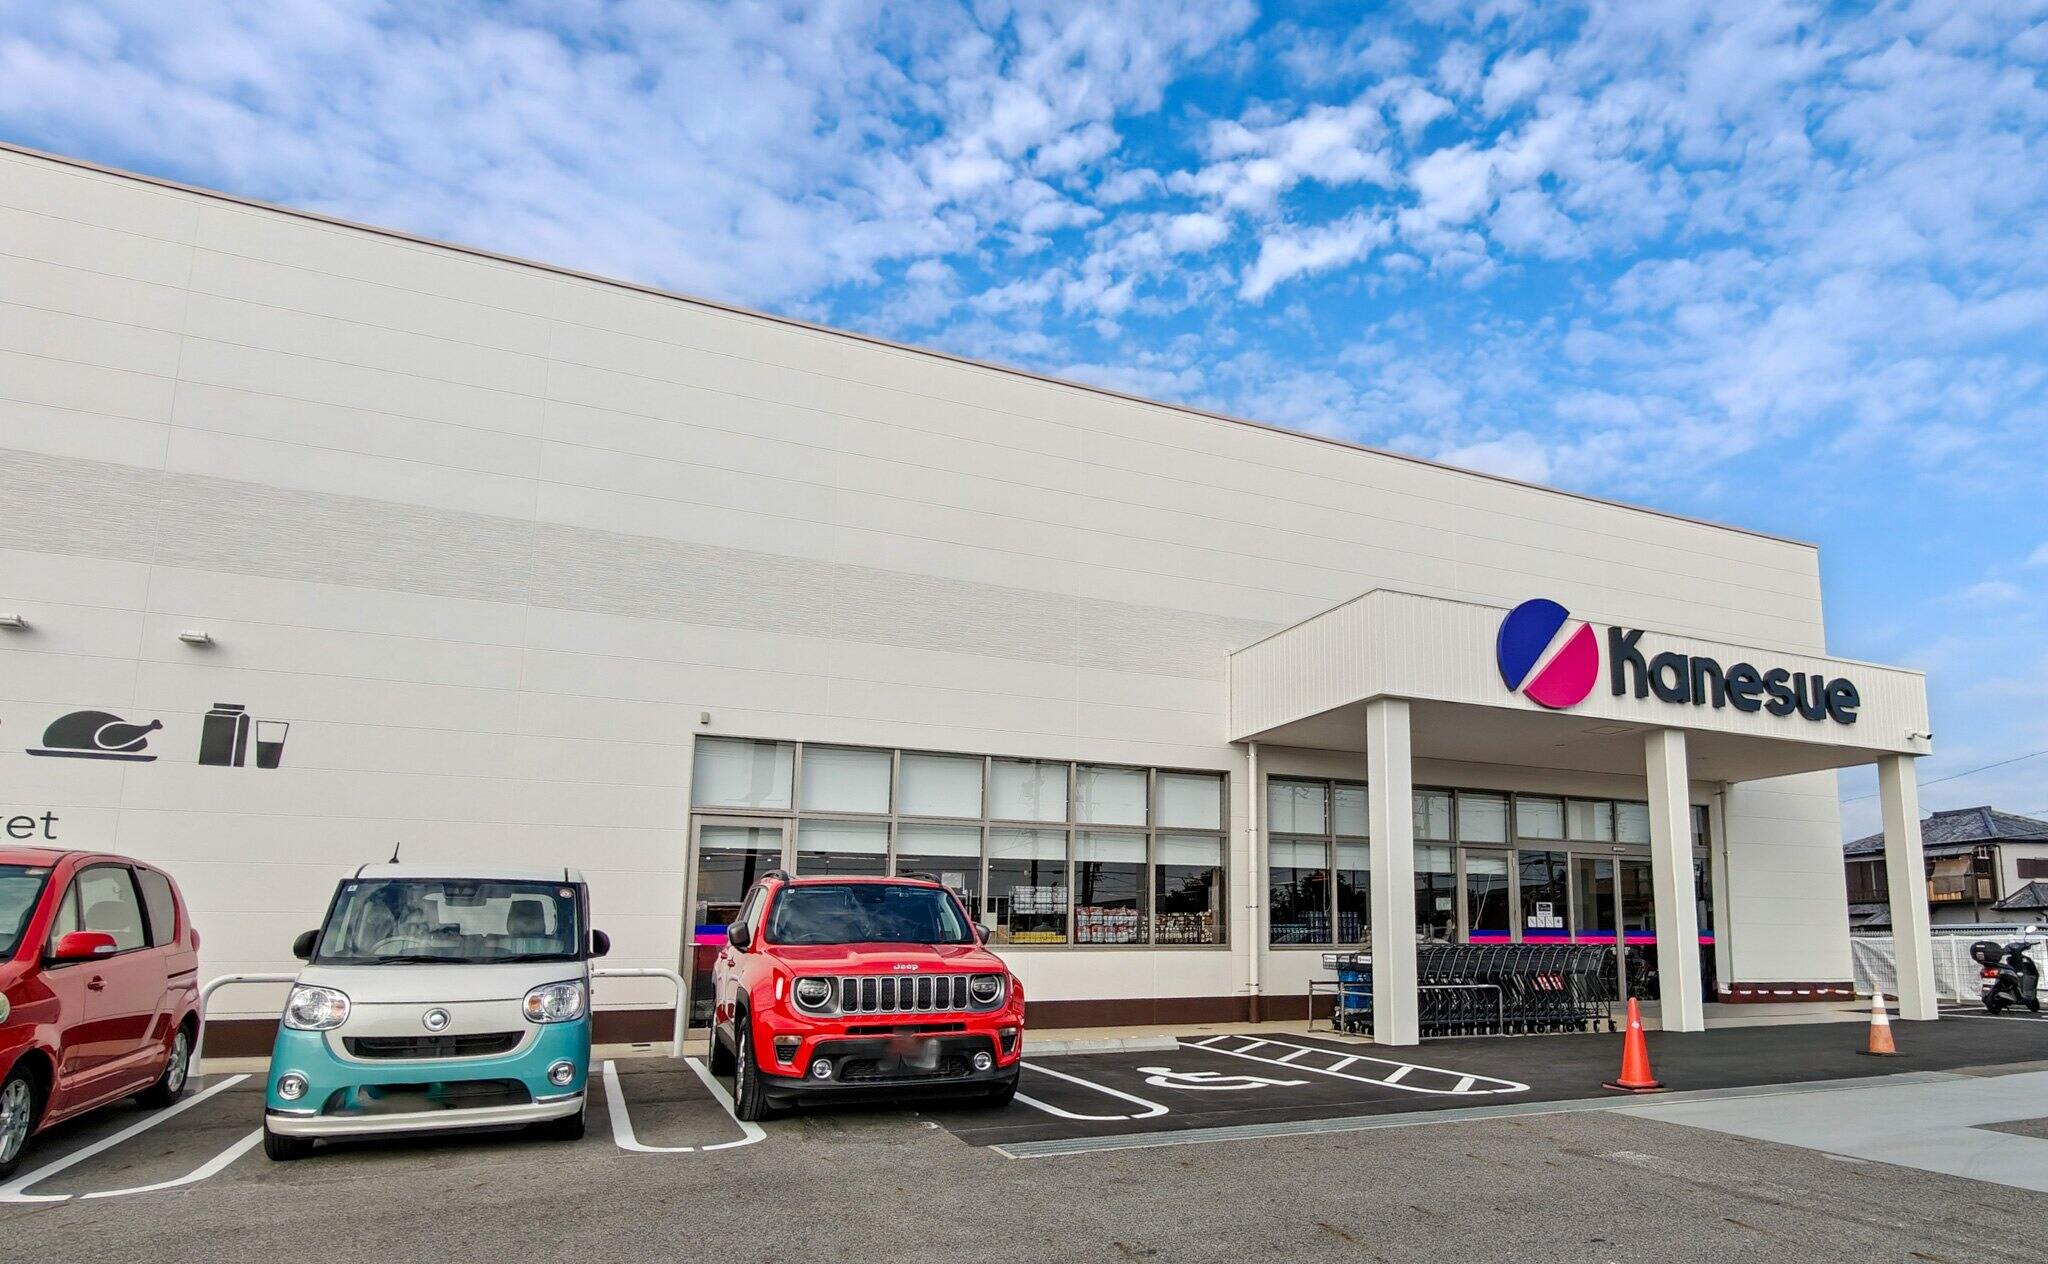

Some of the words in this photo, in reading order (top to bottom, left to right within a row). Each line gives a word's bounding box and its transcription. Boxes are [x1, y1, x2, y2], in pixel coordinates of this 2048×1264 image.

[1608, 626, 1860, 724] Kanesue
[0, 811, 59, 840] et
[893, 963, 919, 971] Jeep
